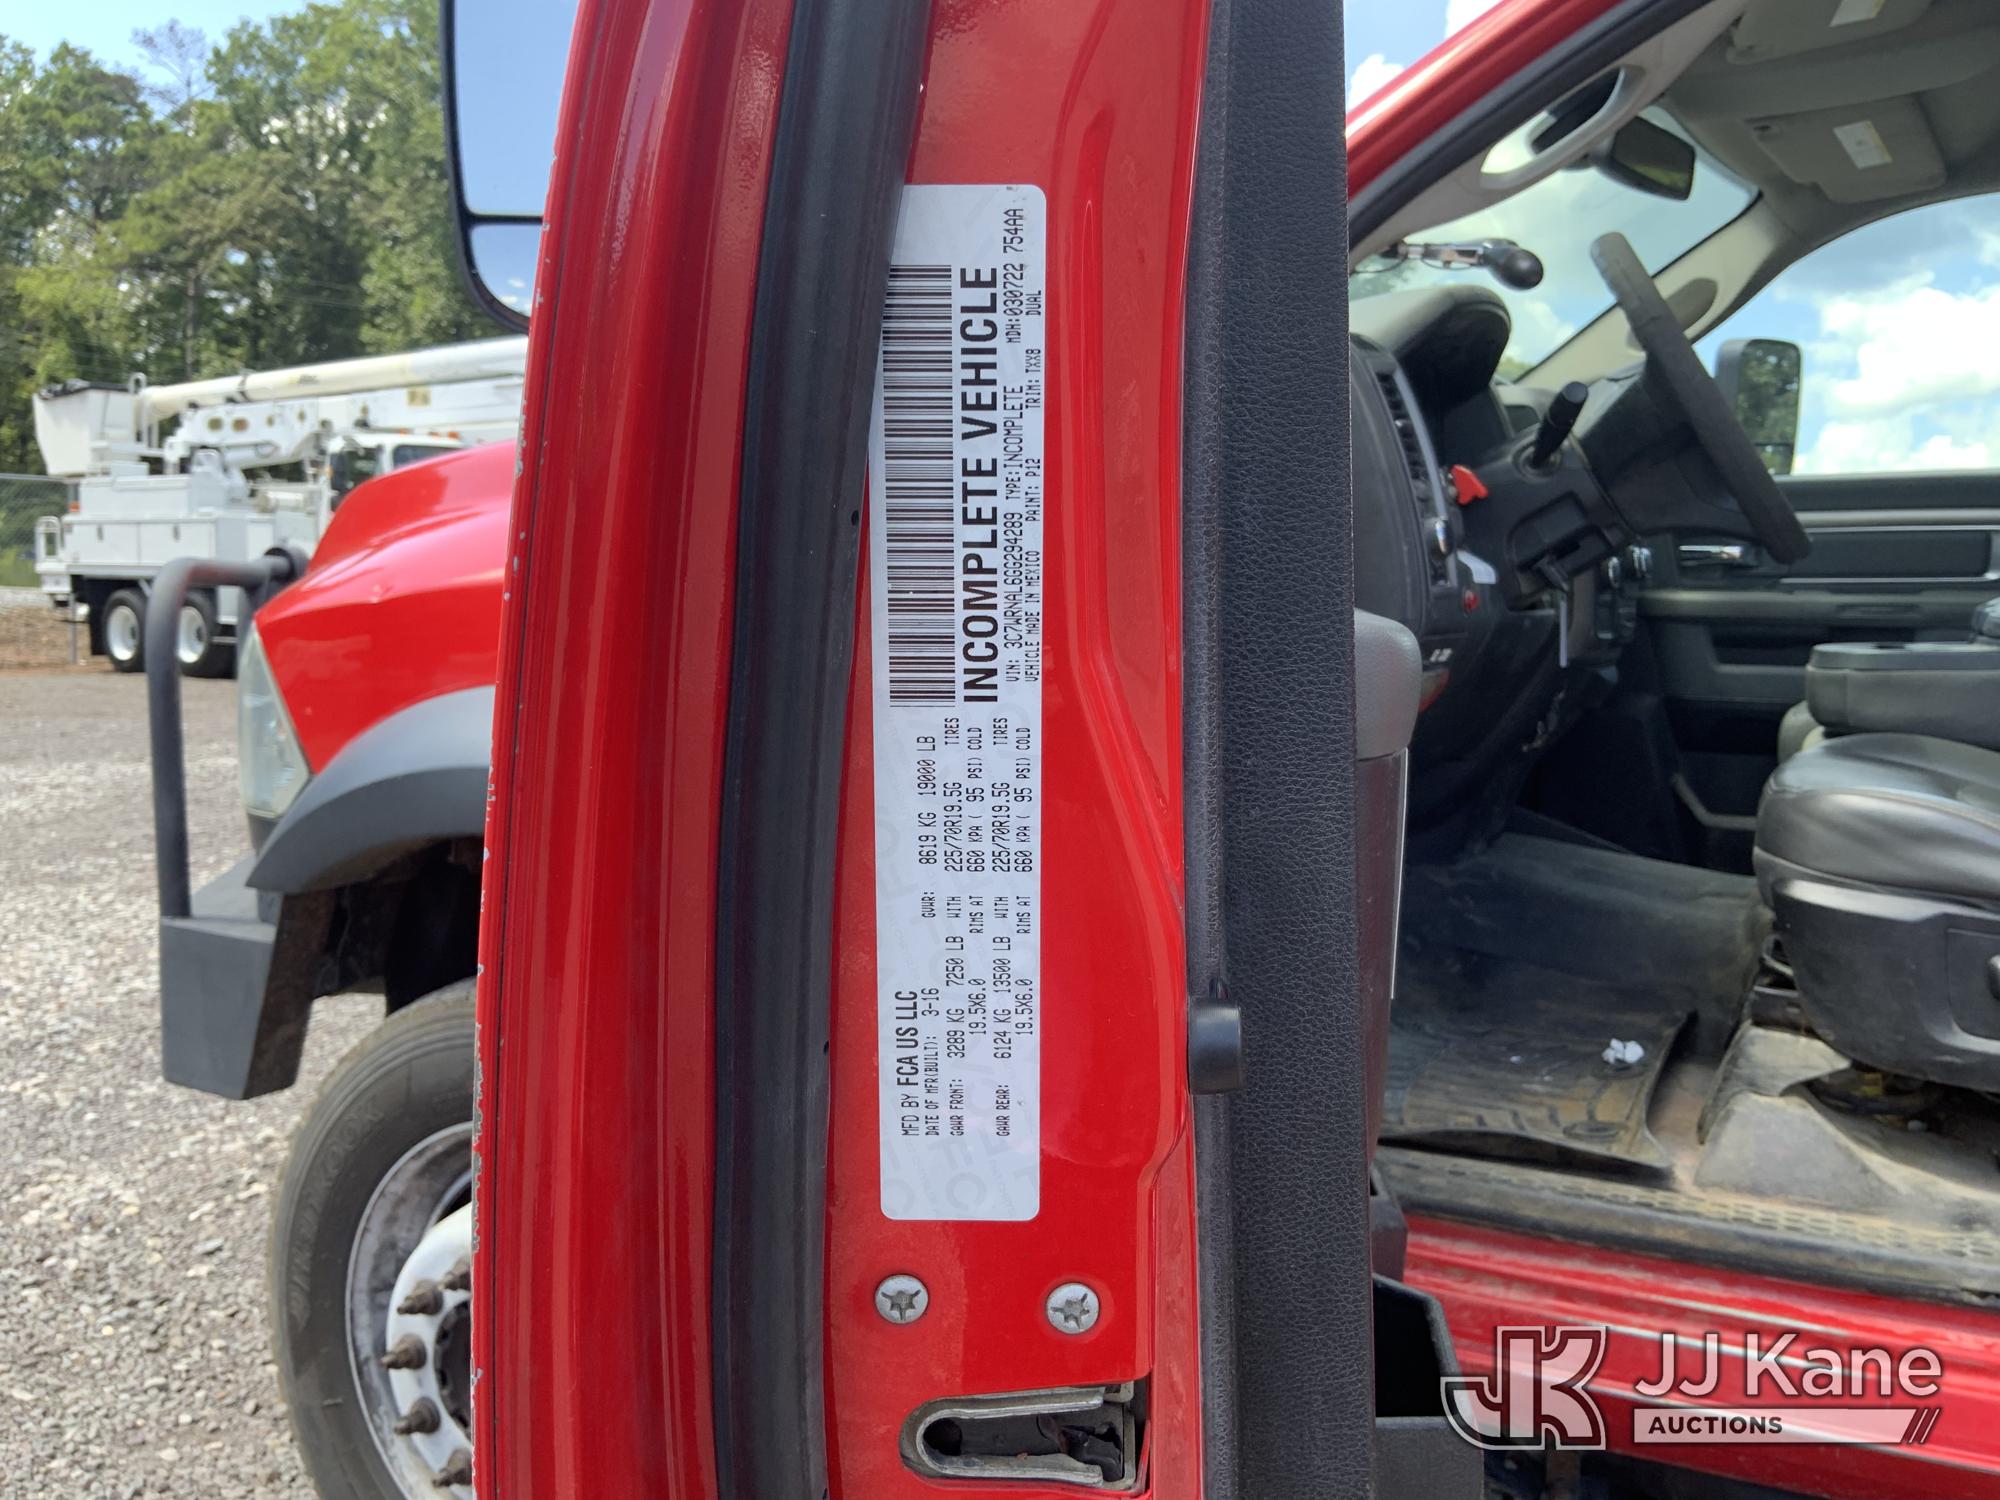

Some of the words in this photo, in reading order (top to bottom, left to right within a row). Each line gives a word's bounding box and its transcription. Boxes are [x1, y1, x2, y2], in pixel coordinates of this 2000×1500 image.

[1003, 208, 1024, 254] 754AA
[1025, 290, 1042, 316] DUAL
[959, 267, 998, 441] VEHICLE
[1025, 348, 1041, 374] TXX8
[1025, 379, 1041, 409] TRIM:
[1025, 458, 1041, 477] P12
[1024, 486, 1041, 522] PAINT:
[961, 457, 999, 703] INCOMPLETE
[1024, 550, 1040, 587] MEXICO
[1003, 512, 1023, 649] 3C7WRNAL6GG294289
[1024, 593, 1040, 603] IN
[1024, 611, 1040, 635] MADE
[1005, 660, 1021, 682] VIN:
[1024, 641, 1040, 682] VEHICLE
[944, 717, 960, 746] TIRES
[967, 727, 982, 750] COLD
[992, 717, 1008, 746] TIRES
[1015, 727, 1031, 751] COLD
[916, 736, 936, 751] LB
[916, 759, 936, 796] 19000
[967, 757, 983, 779] PSI)
[1015, 757, 1031, 779] PSI)
[965, 787, 985, 802] 95
[1013, 787, 1033, 803] 95
[917, 812, 937, 827] KG
[943, 782, 963, 872] 225/70R19.5G
[991, 782, 1011, 873] 225/70R19.5G
[968, 825, 983, 843] KPA
[1015, 825, 1030, 843] KPA
[918, 834, 937, 865] 8619
[966, 850, 985, 872] 660
[1014, 850, 1033, 873] 660
[921, 891, 936, 918] GVWR:
[946, 896, 962, 918] WITH
[968, 895, 983, 906] AT
[994, 896, 1009, 919] WITH
[1016, 895, 1030, 907] AT
[969, 911, 984, 934] RIMS
[1016, 912, 1031, 934] RIMS
[945, 936, 964, 951] LB
[992, 936, 1011, 951] LB
[945, 958, 964, 987] 7250
[992, 958, 1011, 993] 13500
[894, 991, 918, 1020] LLC
[920, 988, 940, 1017] 3-16
[967, 978, 987, 1035] 19.5X6.0
[1014, 978, 1033, 1035] 19.5X6.0
[946, 1008, 965, 1023] KG
[993, 1008, 1012, 1024] KG
[895, 1027, 919, 1049] US
[946, 1030, 965, 1059] 3289
[993, 1030, 1012, 1059] 6124
[896, 1055, 919, 1086] FCA
[923, 1036, 939, 1094] MFR(BUILT):
[901, 1093, 919, 1108] BY
[924, 1099, 939, 1110] OF
[949, 1079, 964, 1110] FRONT:
[995, 1085, 1010, 1110] REAR:
[901, 1114, 920, 1136] MFD
[924, 1115, 940, 1136] DATE
[949, 1115, 964, 1136] GAWR
[995, 1115, 1010, 1137] GAWR
